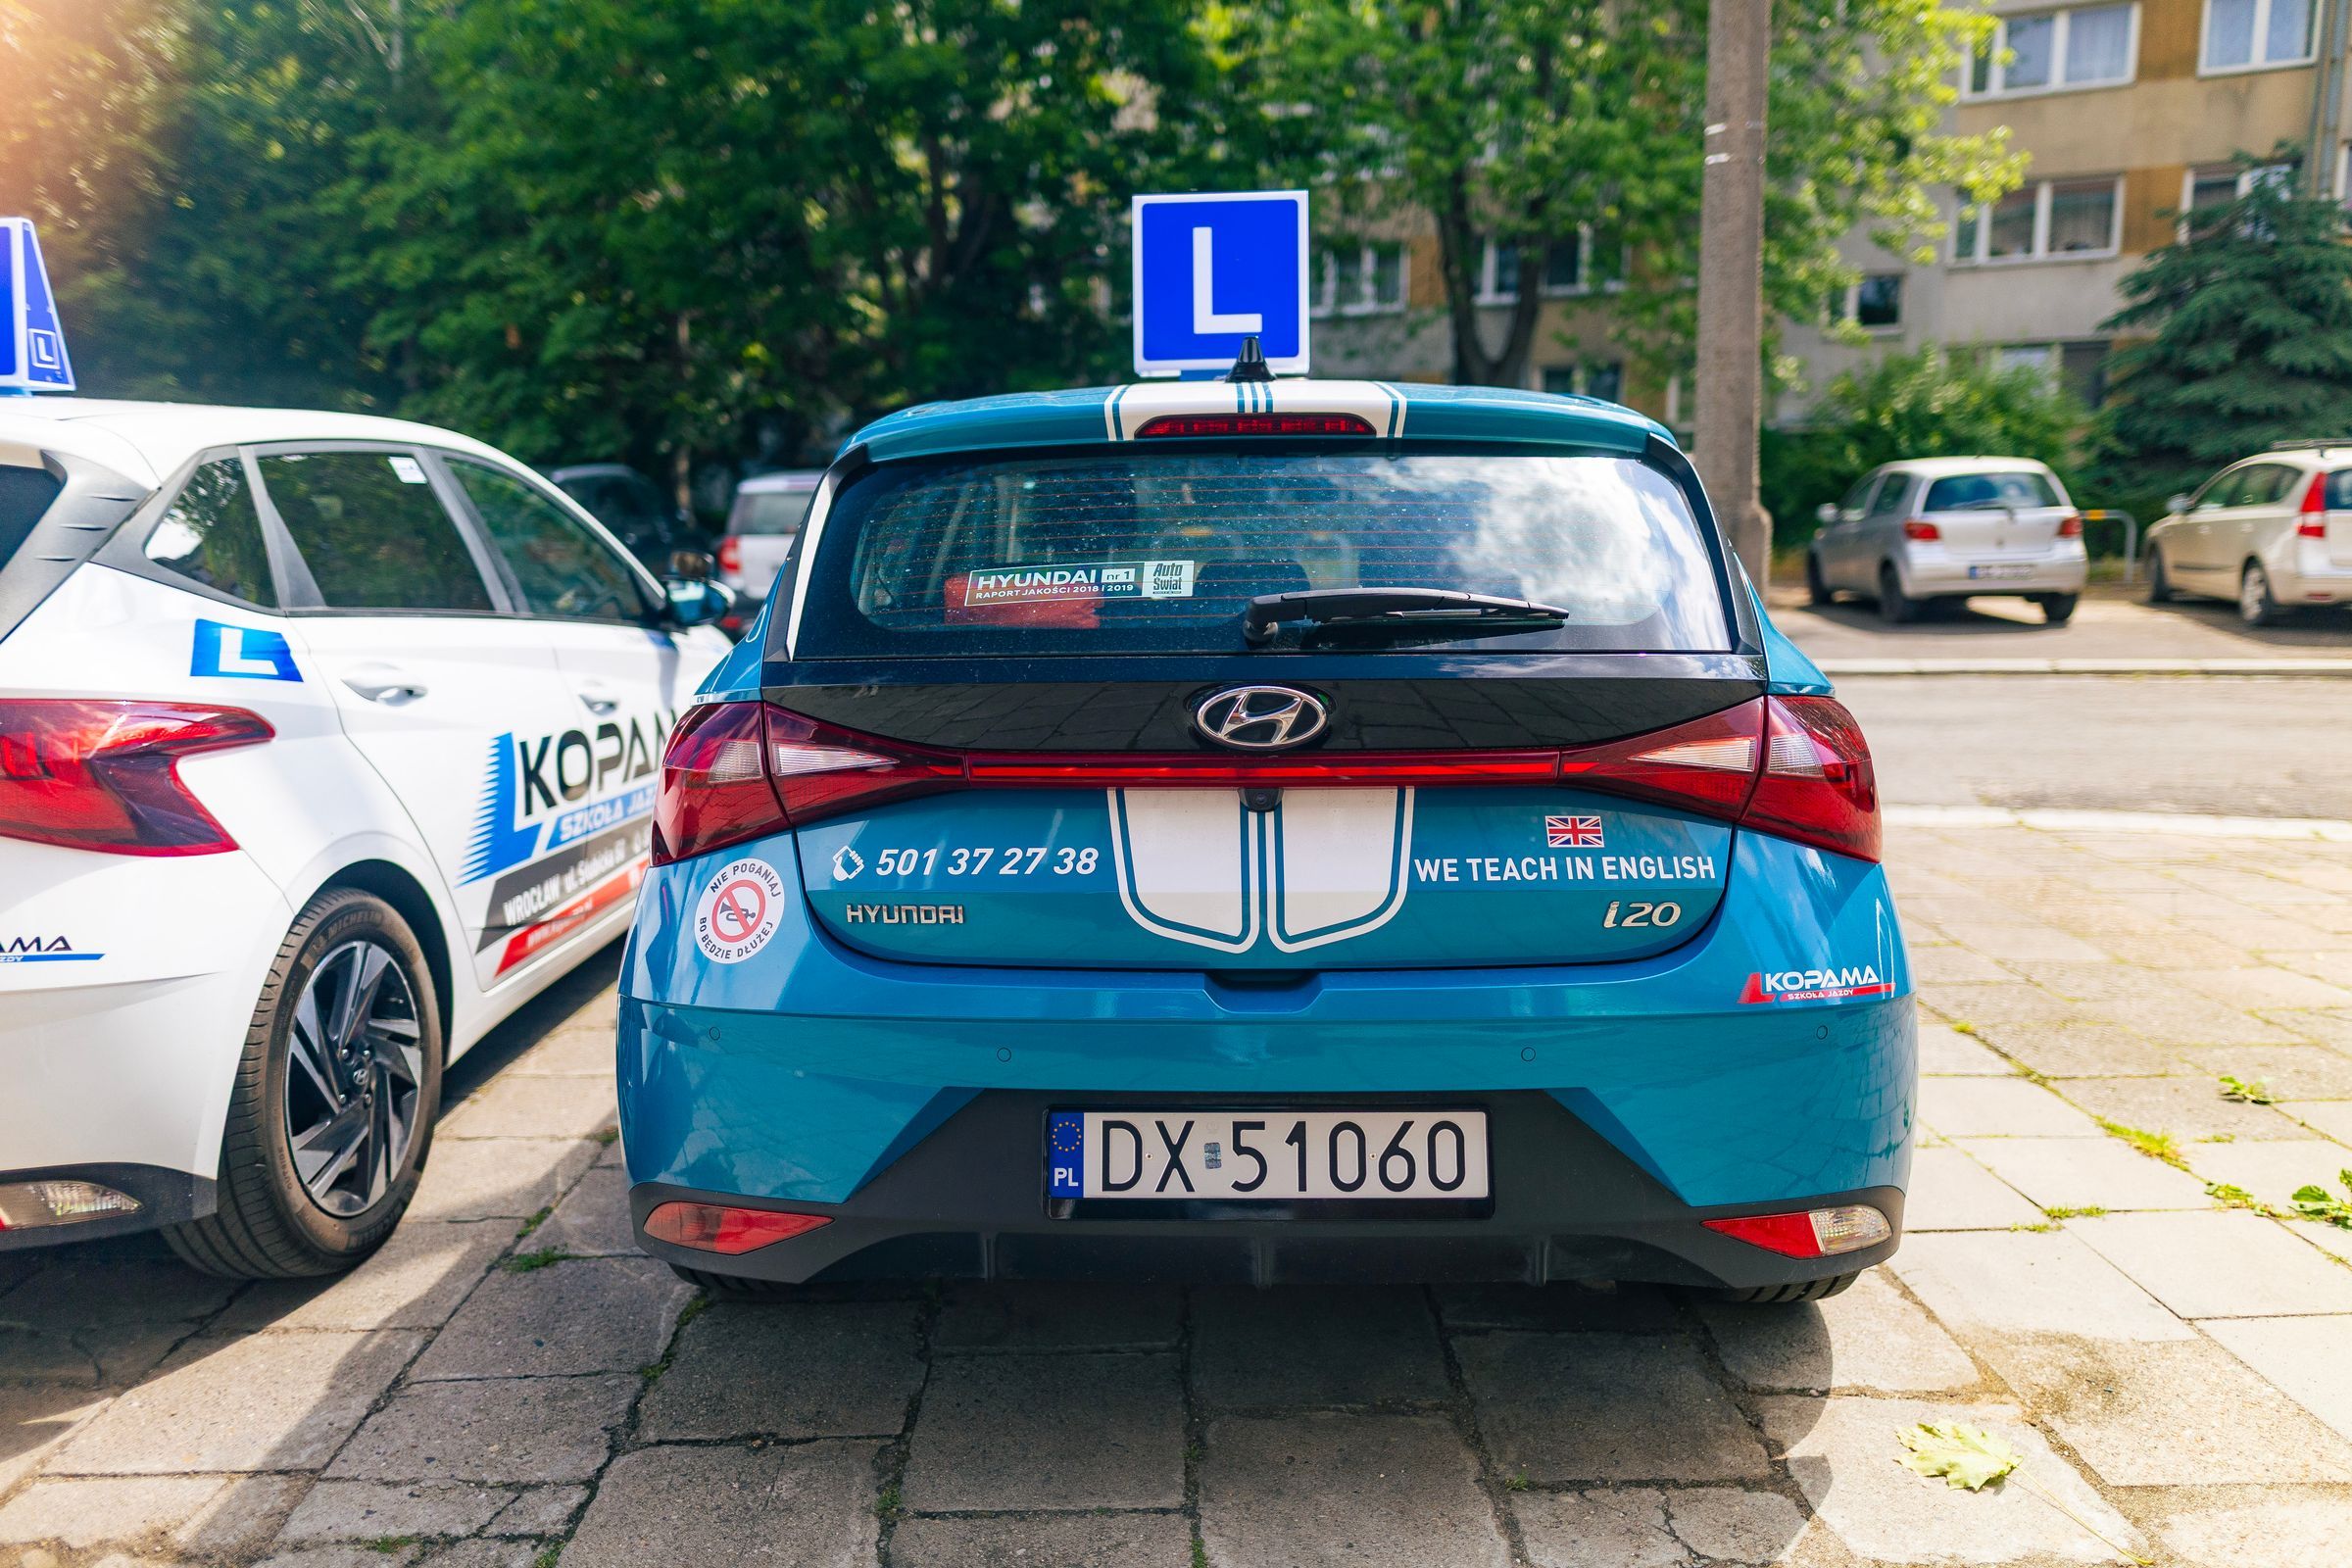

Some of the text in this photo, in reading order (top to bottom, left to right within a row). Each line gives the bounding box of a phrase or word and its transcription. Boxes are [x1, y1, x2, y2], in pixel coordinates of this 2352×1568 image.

[1193, 226, 1263, 334] L
[37, 336, 54, 362] L
[977, 569, 1097, 590] HYUNDAI
[1124, 570, 1130, 580] 1
[1152, 563, 1183, 576] Auto
[975, 589, 1020, 599] RAPORT
[1022, 586, 1070, 596] JAKOŚCI
[219, 627, 279, 675] L
[519, 709, 677, 816] KOPA
[876, 848, 1099, 875] 501 37 27 38
[1414, 857, 1715, 881] WE TEACH IN ENGLISH
[710, 863, 781, 898] NIE POGANIAJ
[847, 905, 963, 924] HYUNDAI
[1603, 901, 1682, 928] i20
[699, 916, 773, 959] BO BĘDZIE DŁUŻEJ
[1765, 964, 1880, 992] KOPAMA
[1788, 989, 1854, 1001] SZKOŁA JAZDY
[1102, 1120, 1466, 1192] DX 51060
[1054, 1167, 1079, 1187] PL
